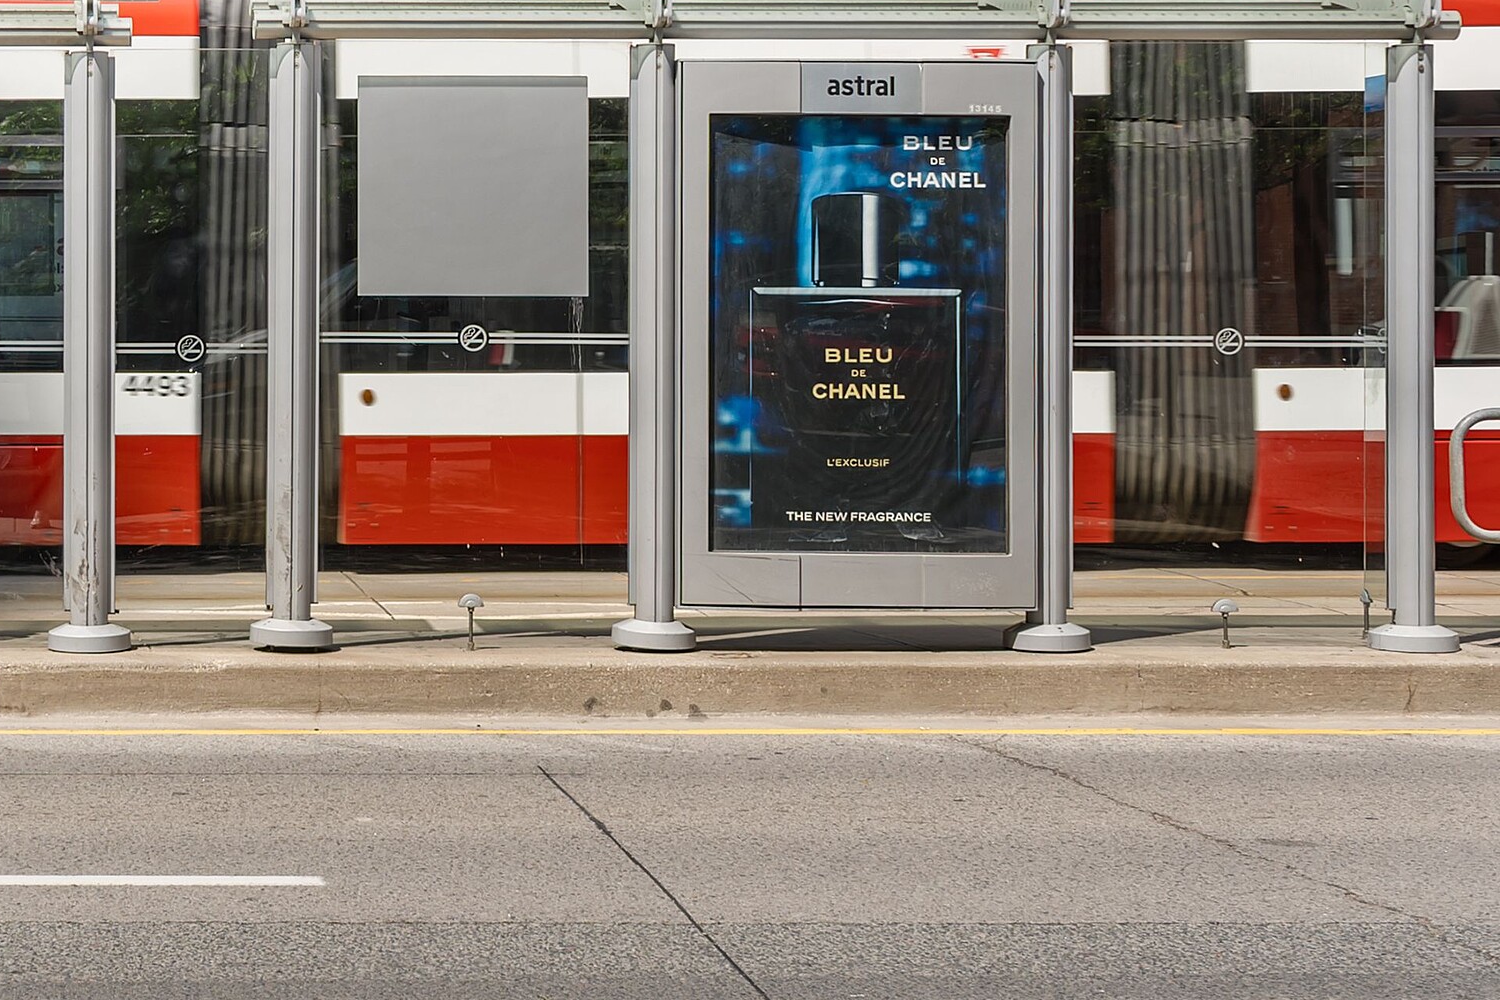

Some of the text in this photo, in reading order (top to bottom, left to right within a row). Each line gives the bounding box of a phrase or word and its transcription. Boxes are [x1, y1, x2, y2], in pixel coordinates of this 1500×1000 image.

[827, 75, 895, 97] astral
[968, 104, 1002, 113] 13145
[903, 135, 973, 151] BLEU
[929, 157, 946, 166] DE
[890, 172, 986, 189] CHANEL
[824, 347, 893, 363] BLEU
[850, 369, 867, 378] DE
[121, 375, 191, 397] 4493
[812, 383, 906, 400] CHANEL
[826, 458, 891, 468] L'EXCLUSIF
[785, 511, 932, 523] THE NEW FRAGRANCE
